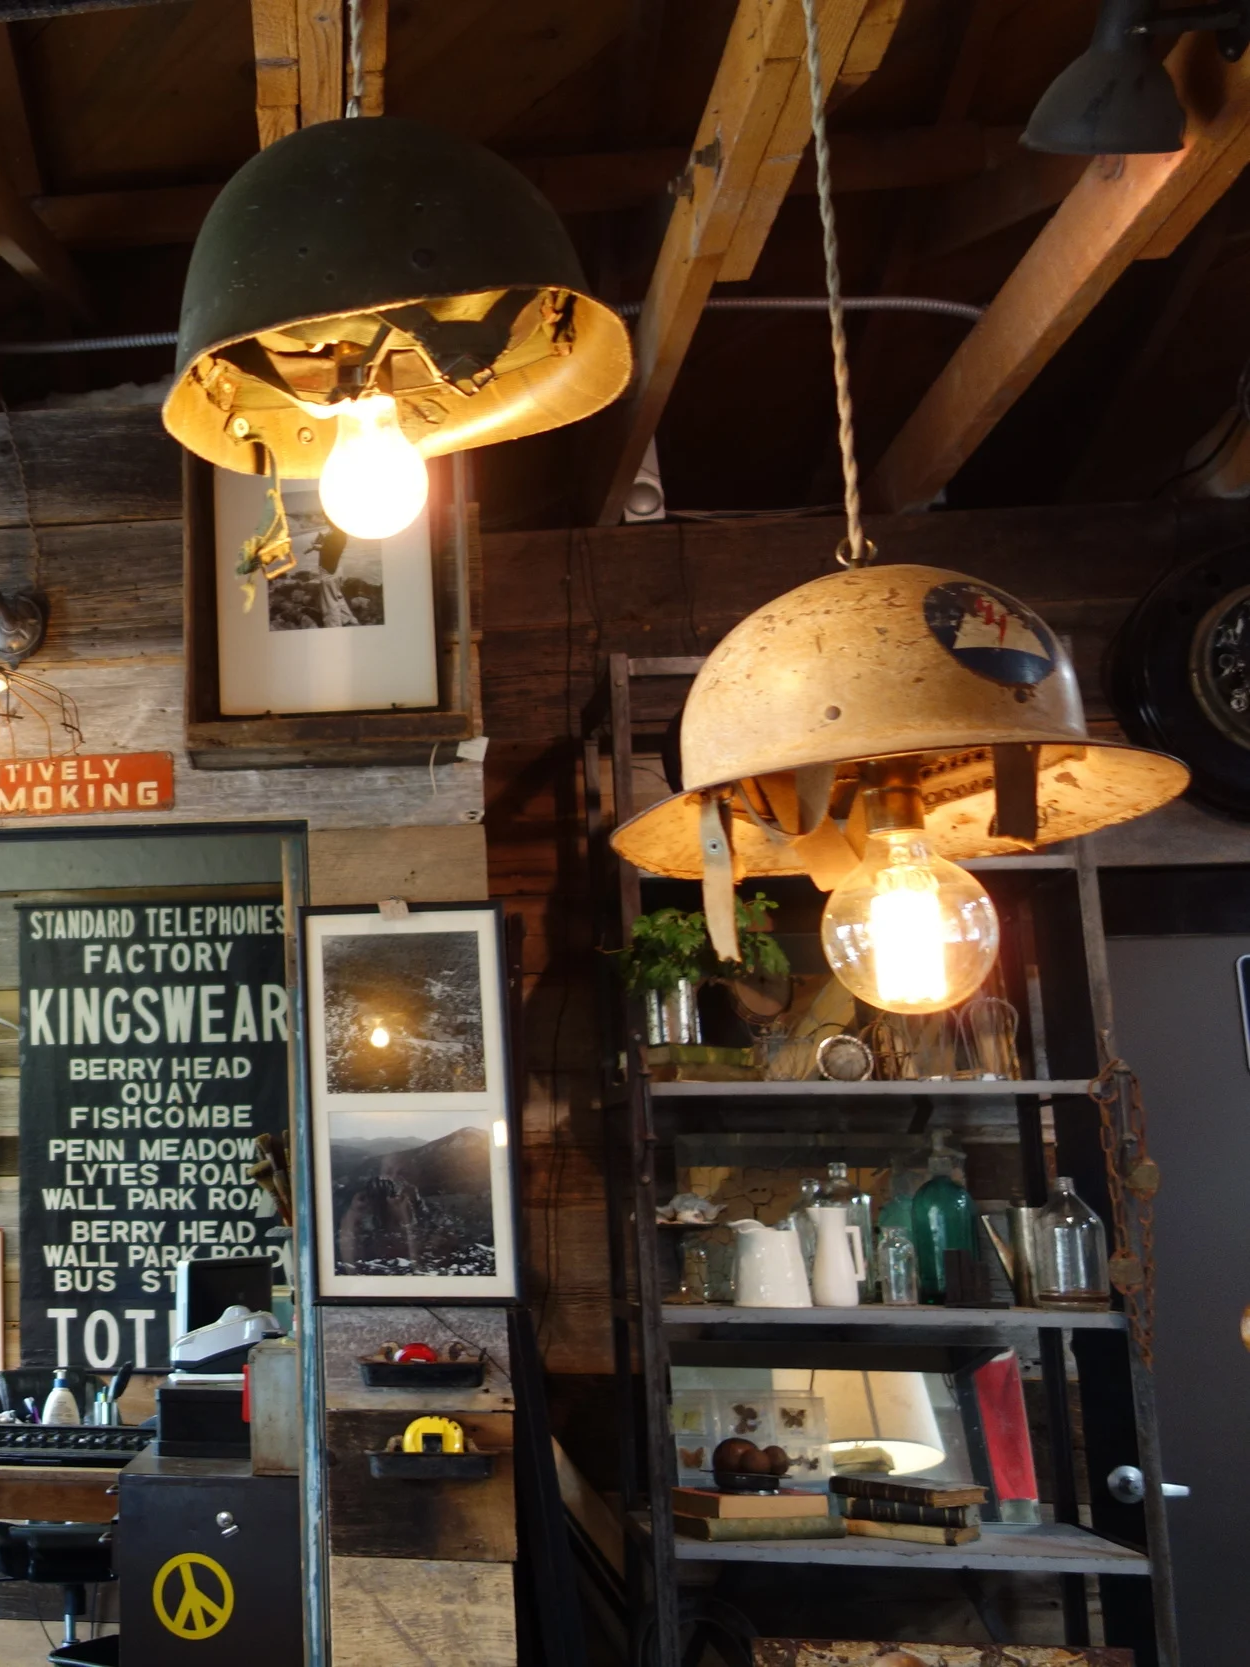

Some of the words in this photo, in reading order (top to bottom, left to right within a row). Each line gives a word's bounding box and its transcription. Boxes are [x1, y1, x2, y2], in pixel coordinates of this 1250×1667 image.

[30, 908, 136, 940] STANDARD
[145, 904, 286, 937] TELEPHONES
[83, 942, 234, 974] FACTORY
[29, 983, 289, 1046] KINGSWEAR
[69, 1058, 163, 1081] BERRY
[172, 1057, 251, 1080] HEAD
[121, 1082, 203, 1105] QUAY
[70, 1105, 253, 1129] FISHCOMBE
[49, 1139, 125, 1161] PENN
[65, 1163, 160, 1186] LYTES
[42, 1188, 116, 1211] WALL
[127, 1188, 197, 1211] PARK
[208, 1188, 264, 1211] ROA
[71, 1221, 166, 1243] BERRY
[178, 1221, 256, 1243] HEAD
[43, 1245, 118, 1268] WALL
[128, 1245, 199, 1268] PARK
[54, 1270, 117, 1292] BUS
